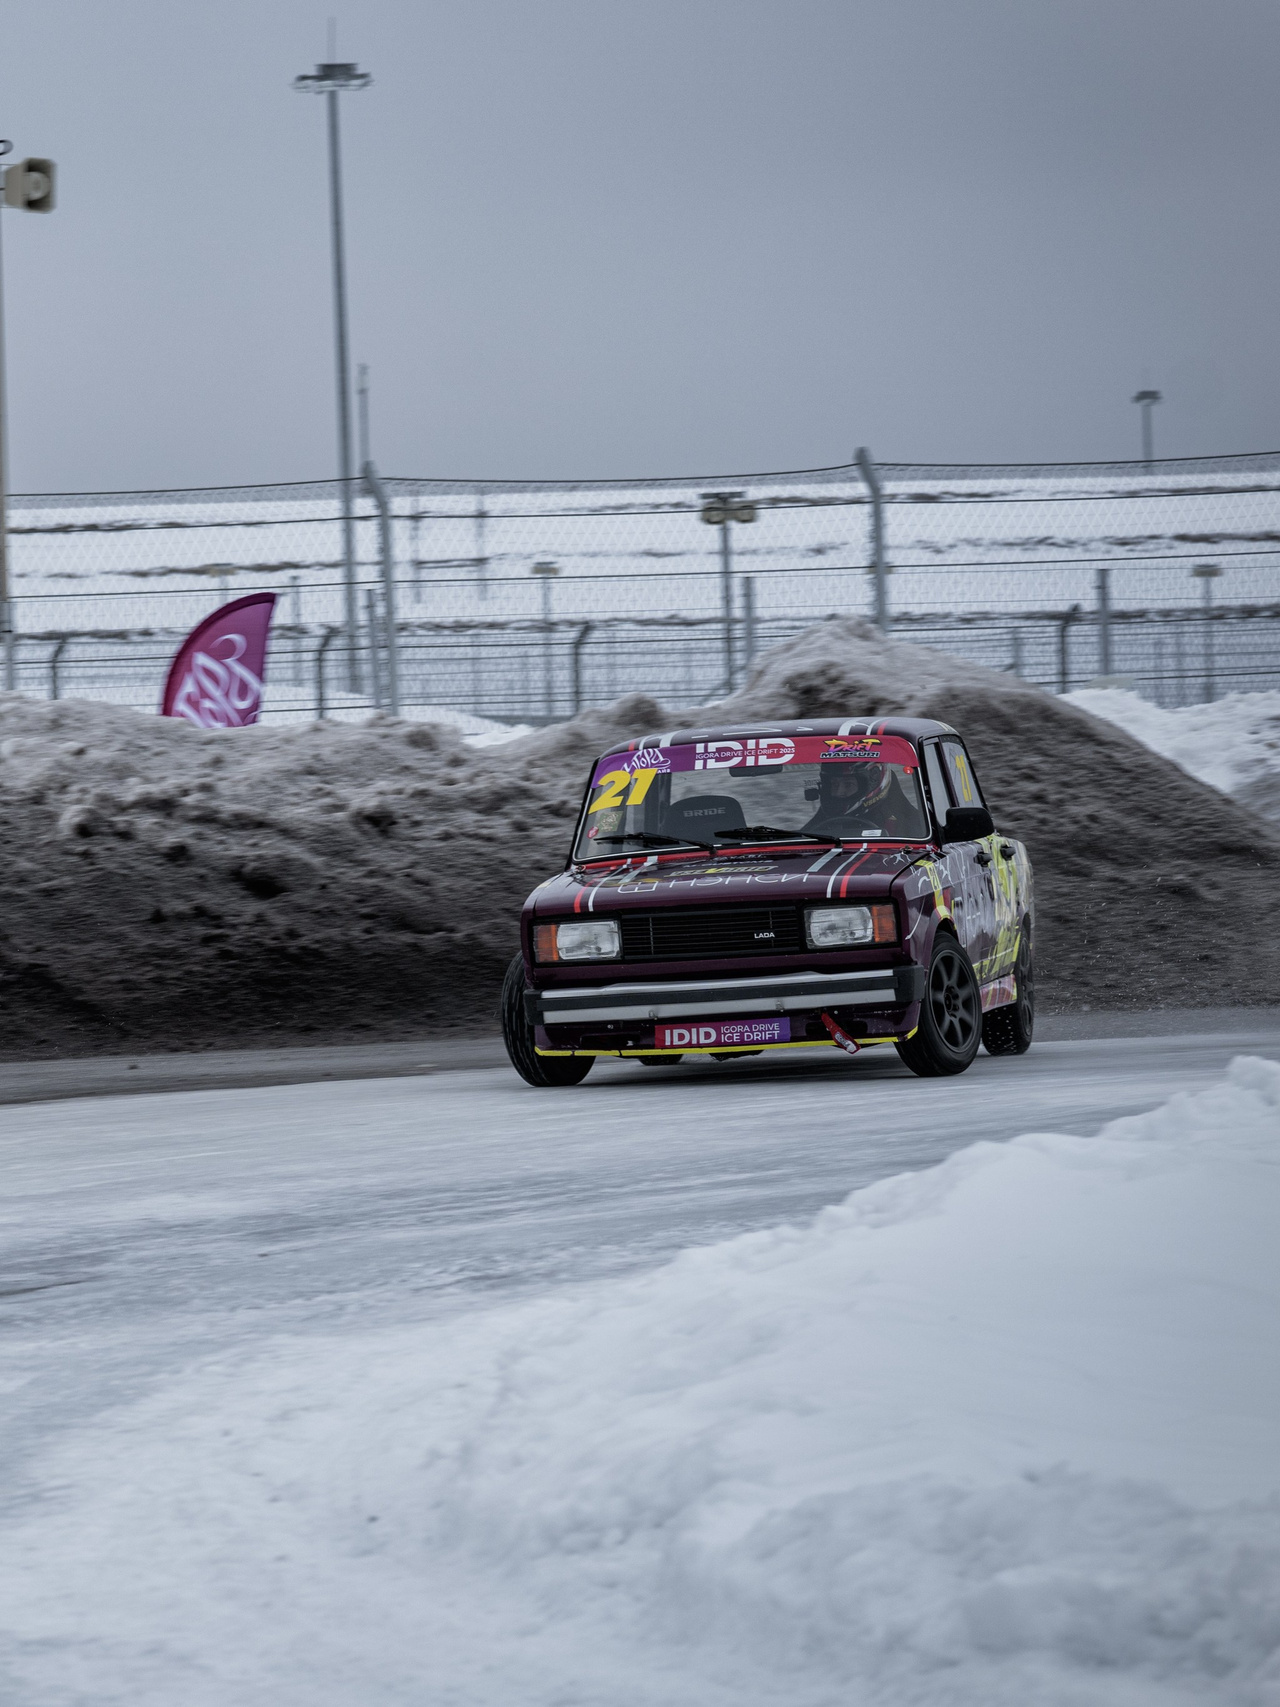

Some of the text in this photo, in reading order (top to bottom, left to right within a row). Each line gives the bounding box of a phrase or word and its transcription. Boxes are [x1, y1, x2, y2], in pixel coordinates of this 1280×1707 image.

[694, 738, 795, 770] IDID
[820, 751, 881, 759] MATSURI
[588, 767, 659, 815] 21
[683, 807, 726, 818] BRIDE
[721, 1022, 780, 1034] IGORA DRIVE
[665, 1027, 717, 1046] IDID
[721, 1031, 780, 1043] ICE DRIFT
